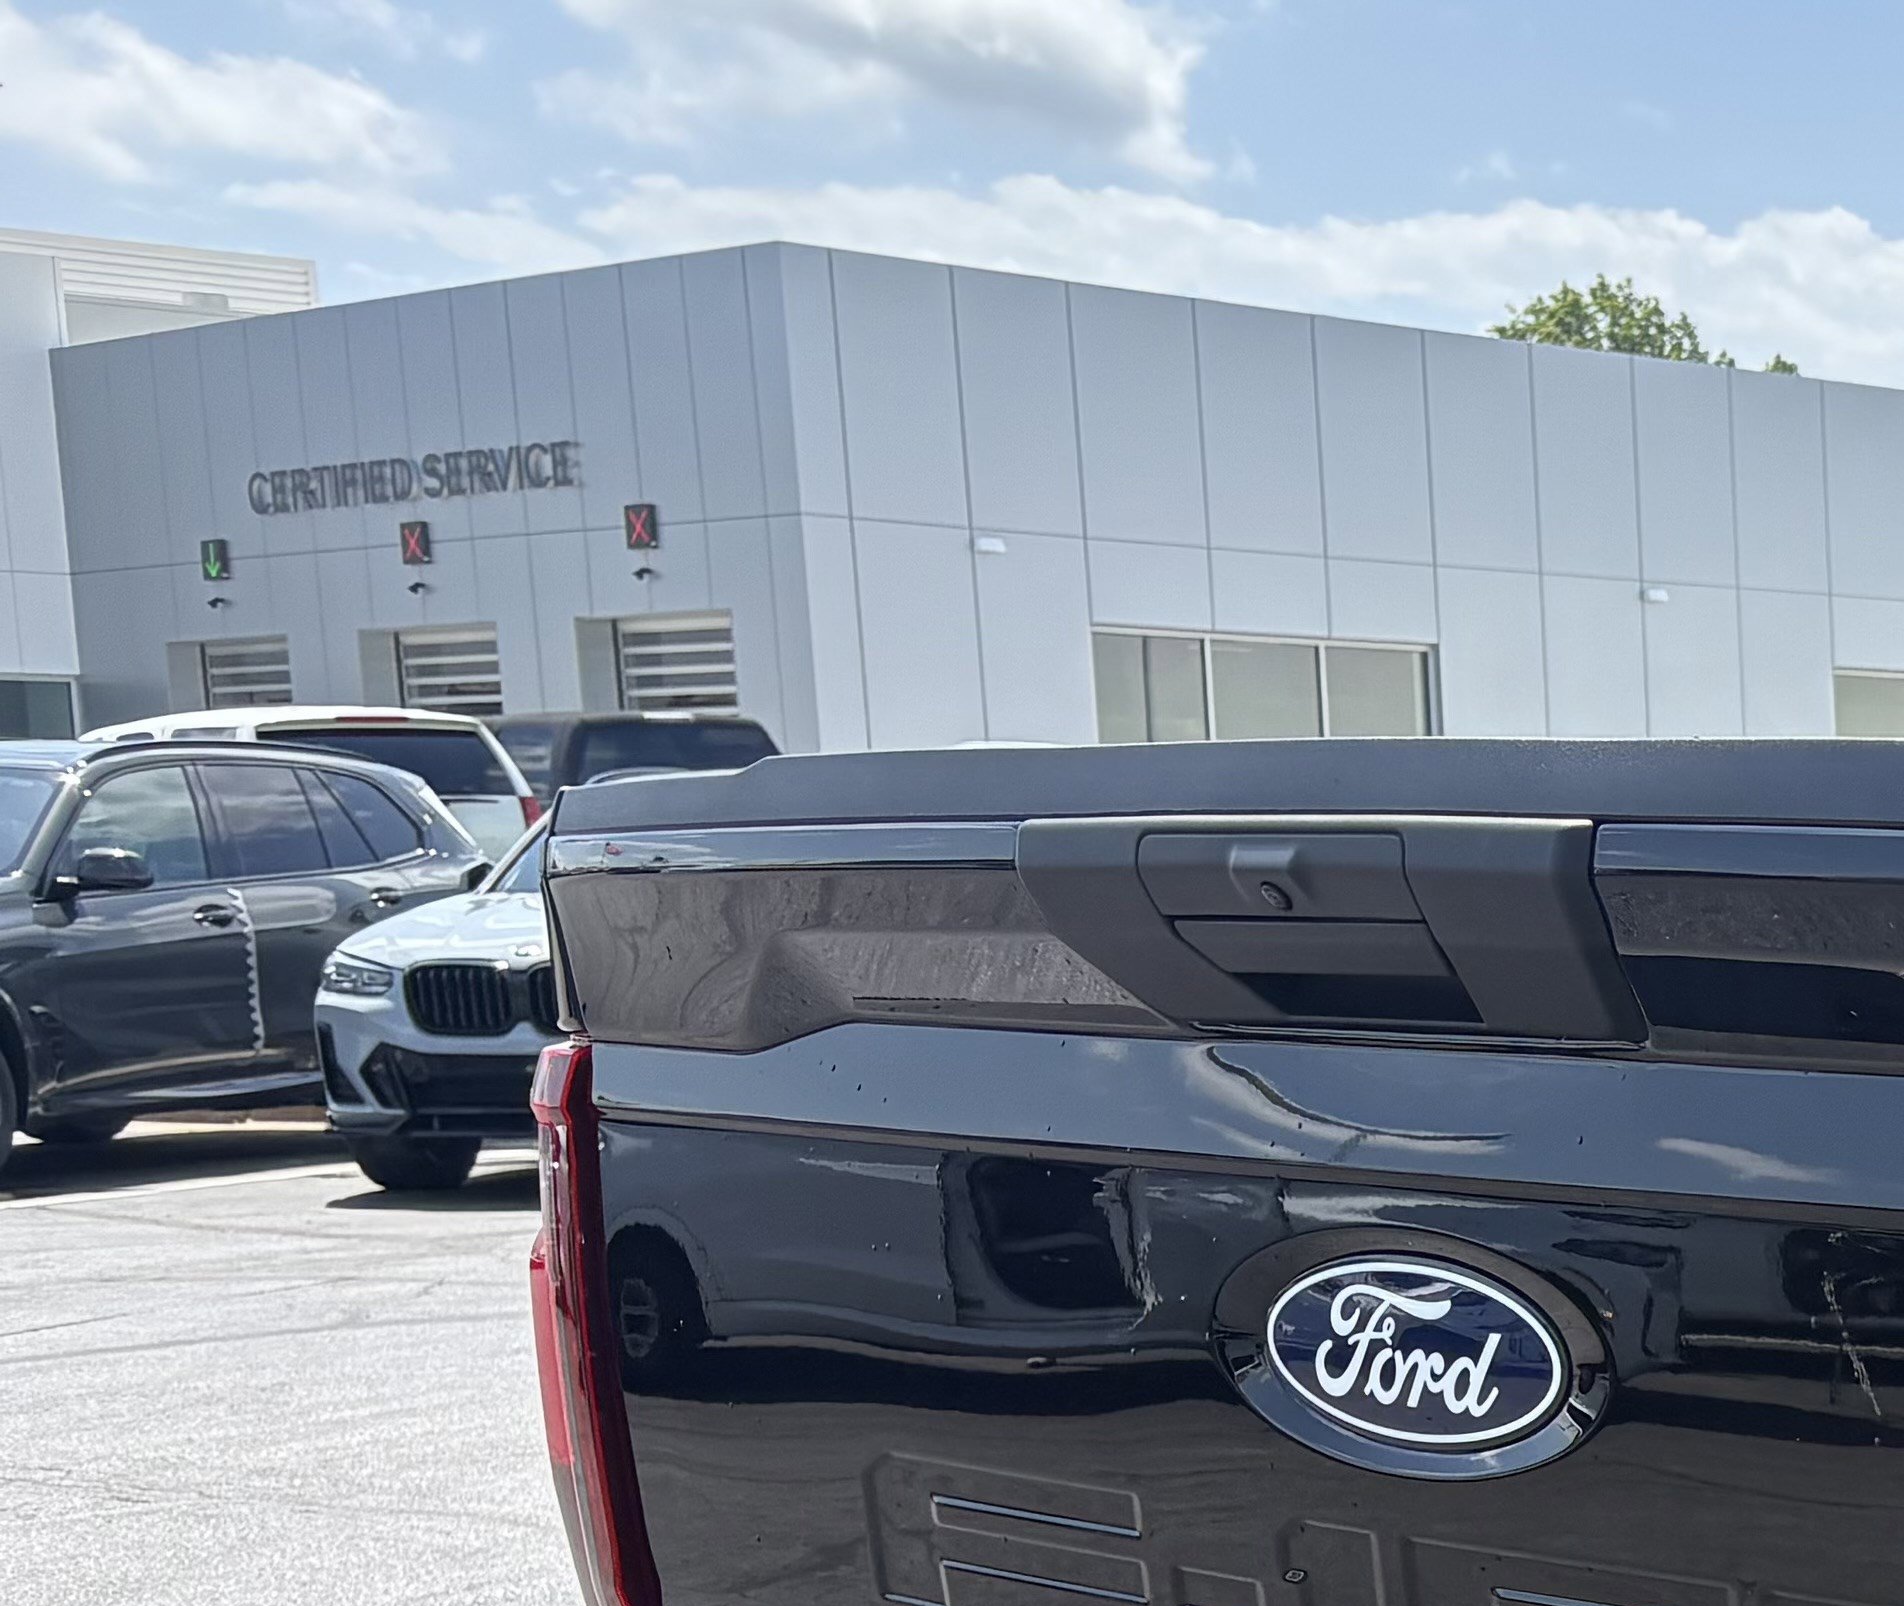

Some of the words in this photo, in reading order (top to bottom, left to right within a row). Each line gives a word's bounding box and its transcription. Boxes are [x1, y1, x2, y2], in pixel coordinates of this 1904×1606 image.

[248, 457, 412, 515] CERTIFIED
[421, 440, 578, 499] SERVICE
[1314, 1283, 1502, 1418] Ford
